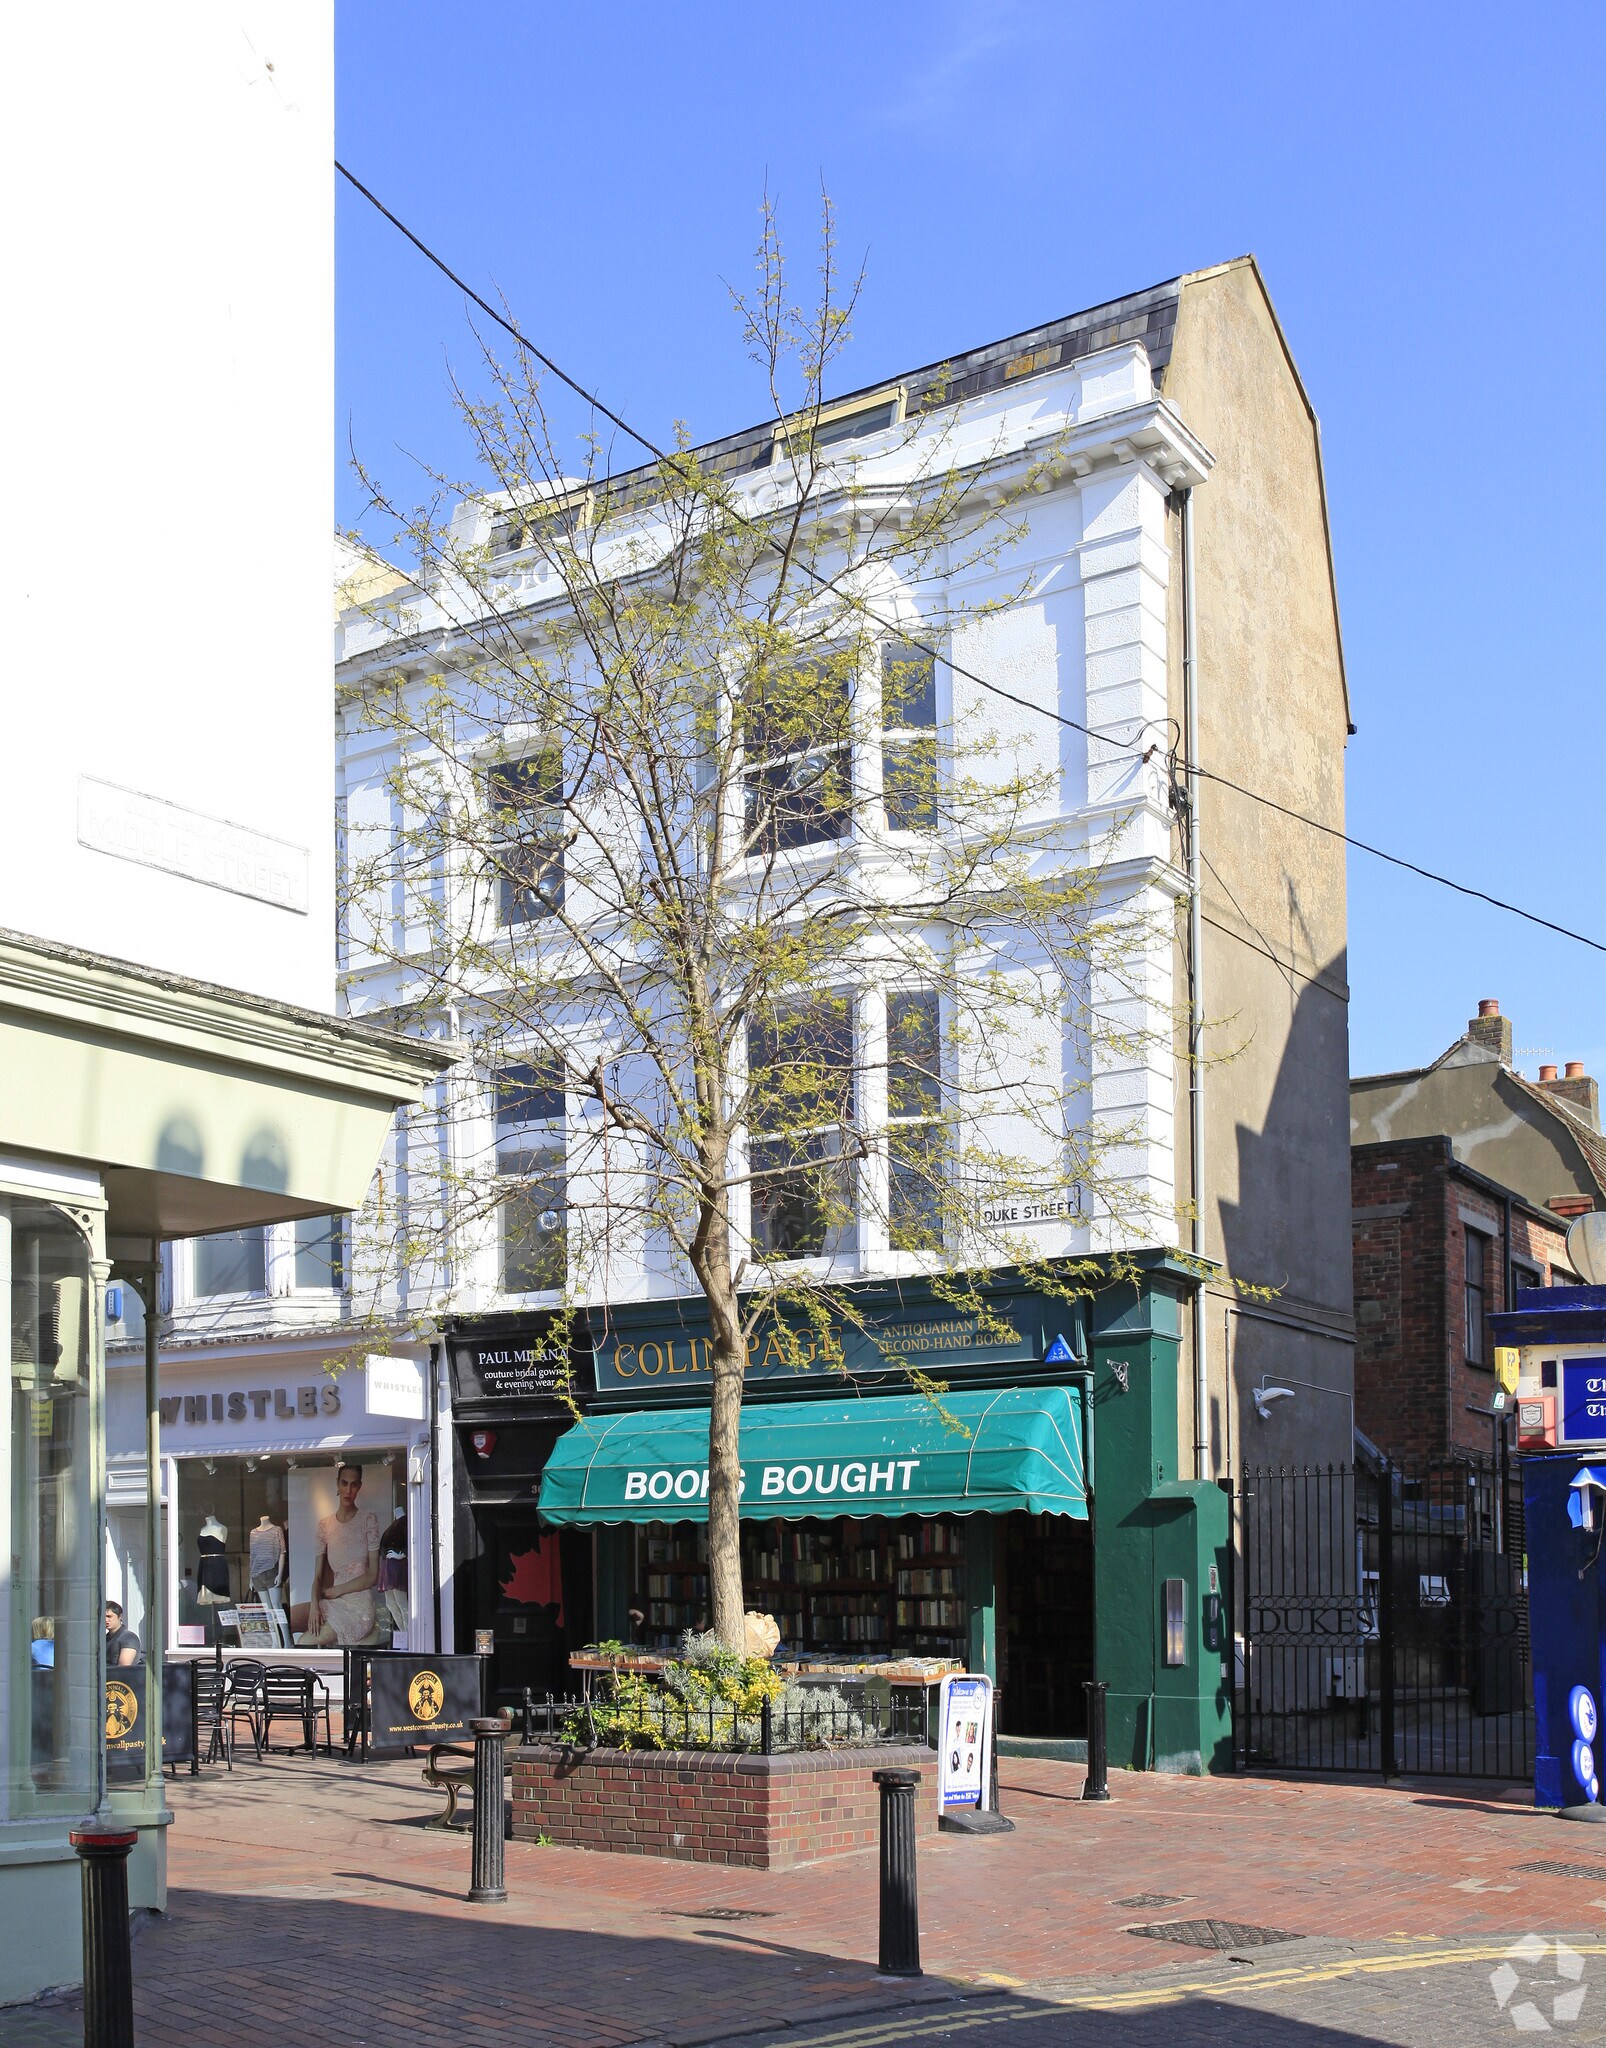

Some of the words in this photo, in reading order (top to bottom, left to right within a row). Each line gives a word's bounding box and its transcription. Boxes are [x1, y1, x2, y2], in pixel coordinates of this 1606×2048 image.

[201, 846, 299, 901] STREET
[983, 1207, 1018, 1223] DUKE
[1023, 1200, 1074, 1219] STREET
[882, 1319, 973, 1338] ANTIQUARIAN
[977, 1316, 1014, 1332] RRE
[878, 1334, 972, 1354] SECOND-HAND
[478, 1351, 512, 1365] PAUL
[484, 1368, 514, 1379] couture
[515, 1367, 537, 1378] bridal
[374, 1380, 423, 1394] WHISTLES
[495, 1380, 503, 1389] &
[504, 1379, 534, 1390] evening
[535, 1379, 556, 1388] wear
[159, 1384, 342, 1425] WHISTLES
[624, 1468, 746, 1500] BOO
[761, 1460, 921, 1496] BOUGHT
[1259, 1608, 1374, 1635] DUKES
[389, 1720, 464, 1734] www.westcornwallpasty.co.uk
